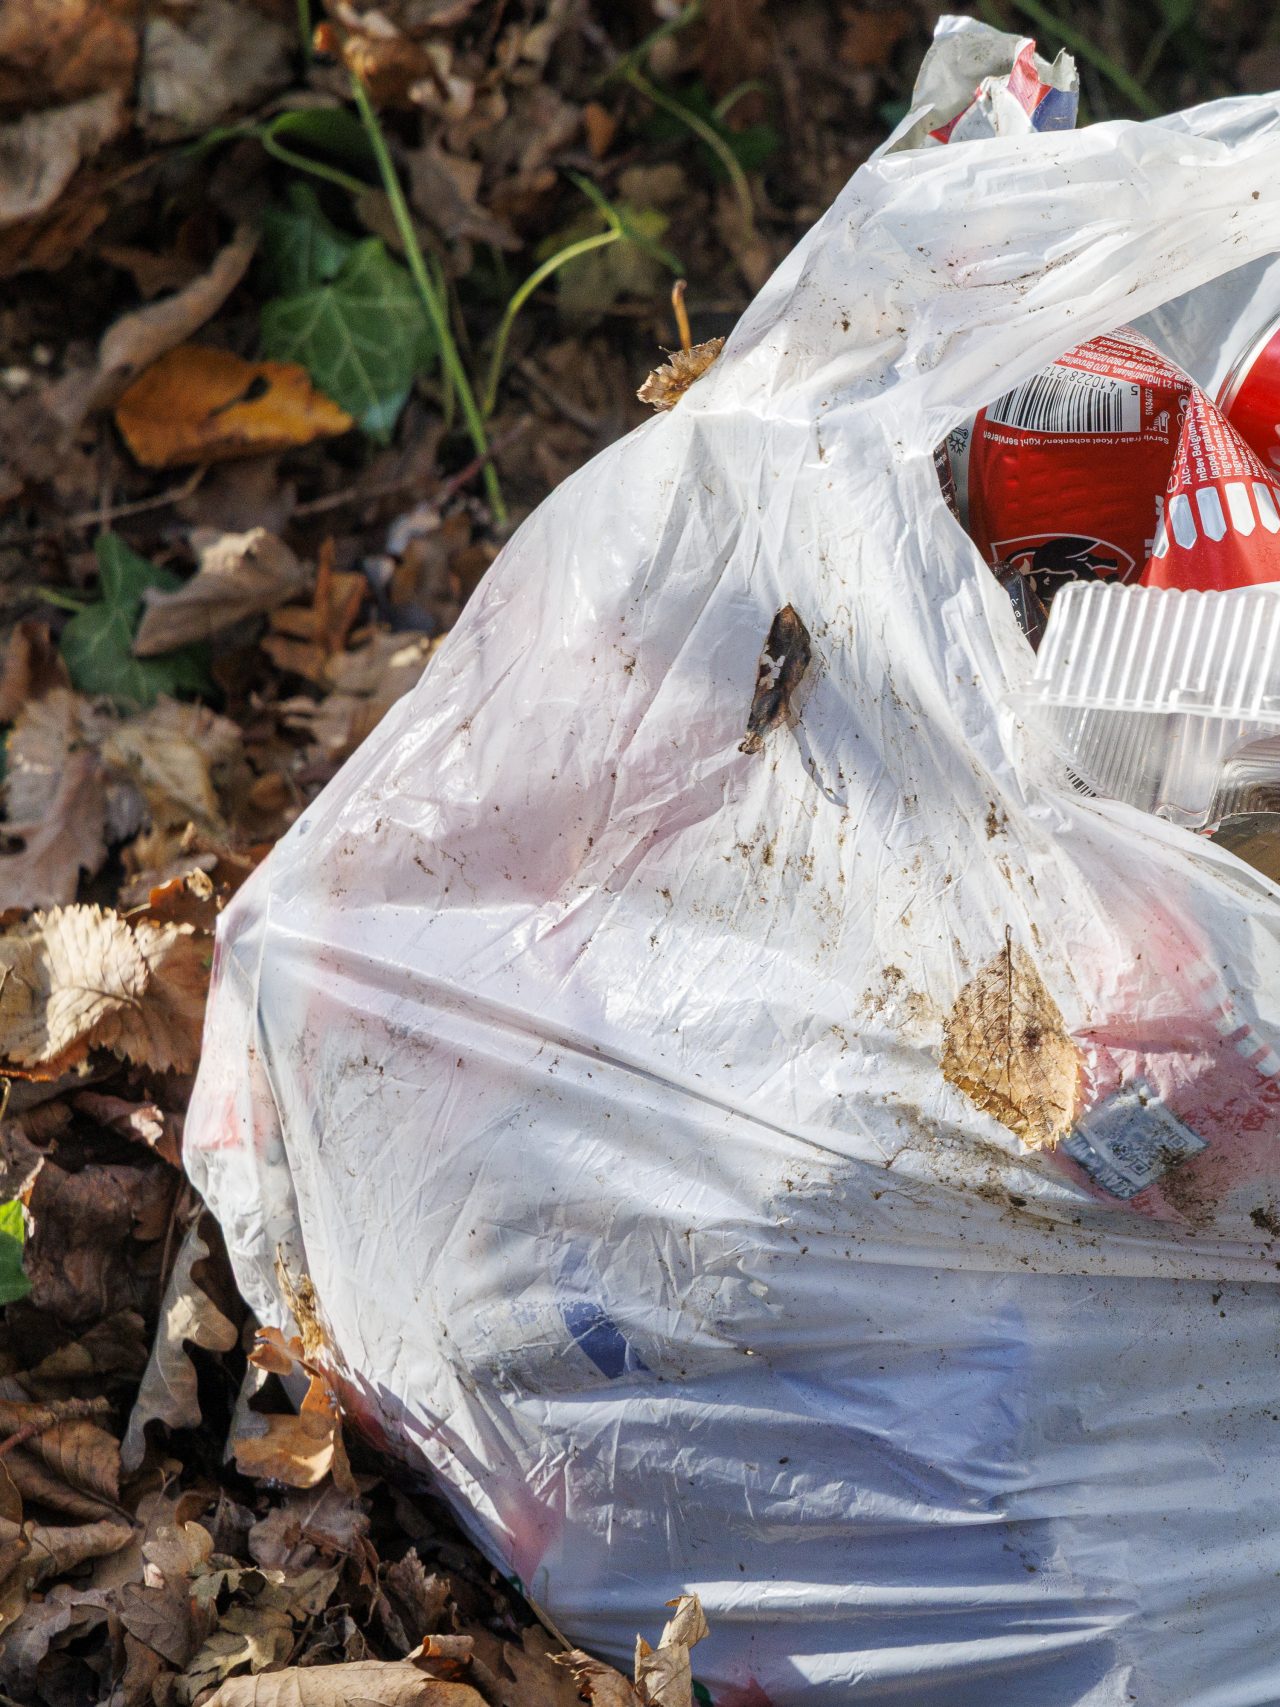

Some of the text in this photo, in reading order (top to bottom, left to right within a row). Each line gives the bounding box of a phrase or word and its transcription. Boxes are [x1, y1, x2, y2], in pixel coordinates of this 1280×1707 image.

[1094, 362, 1109, 372] 1070
[1069, 370, 1116, 392] 410228
[1130, 385, 1138, 395] 5
[1162, 377, 1171, 387] 21
[1195, 405, 1204, 417] bel
[983, 430, 1017, 445] servieren
[1143, 434, 1168, 444] Servir
[1185, 418, 1199, 455] Belgium,
[1199, 423, 1214, 452] gratuit
[1208, 408, 1230, 477] Ingrédients: Eau,
[1182, 465, 1191, 485] Alc.
[1194, 456, 1207, 482] InBev
[1208, 453, 1220, 479] (appel
